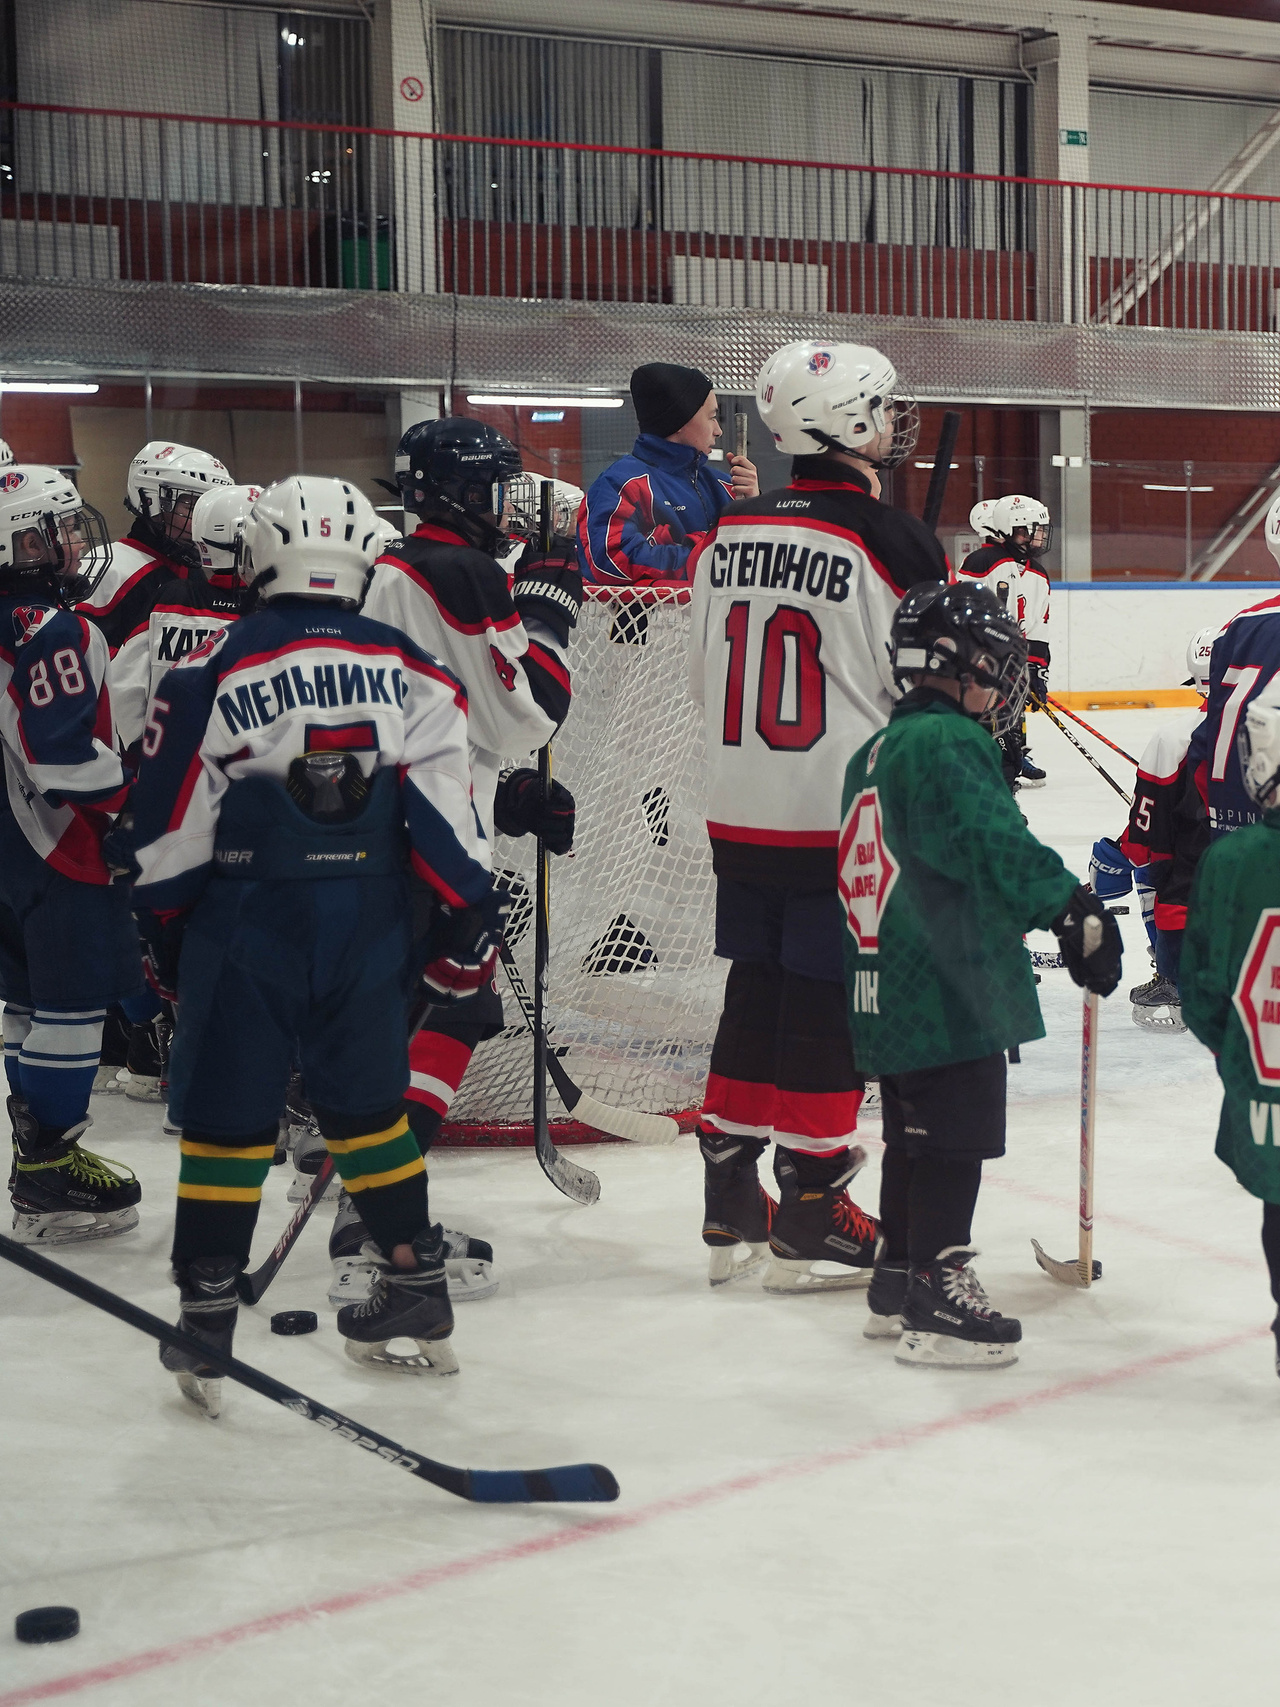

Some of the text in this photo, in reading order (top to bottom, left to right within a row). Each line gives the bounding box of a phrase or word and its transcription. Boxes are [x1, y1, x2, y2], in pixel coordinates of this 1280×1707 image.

[832, 397, 859, 410] BAUER
[461, 454, 492, 462] BAUER
[10, 510, 43, 521] CCM
[319, 517, 332, 538] 5
[709, 541, 854, 603] СТЕПАНОВ
[305, 627, 342, 636] LUTCH
[1198, 646, 1211, 657] 25
[28, 648, 87, 708] 88
[722, 599, 827, 752] 10
[142, 697, 170, 759] 5
[1132, 795, 1155, 832] 5
[1218, 809, 1264, 825] SPIN
[304, 853, 354, 861] SUPREME
[828, 1237, 860, 1252] BAUER
[936, 1311, 961, 1324] BAUER
